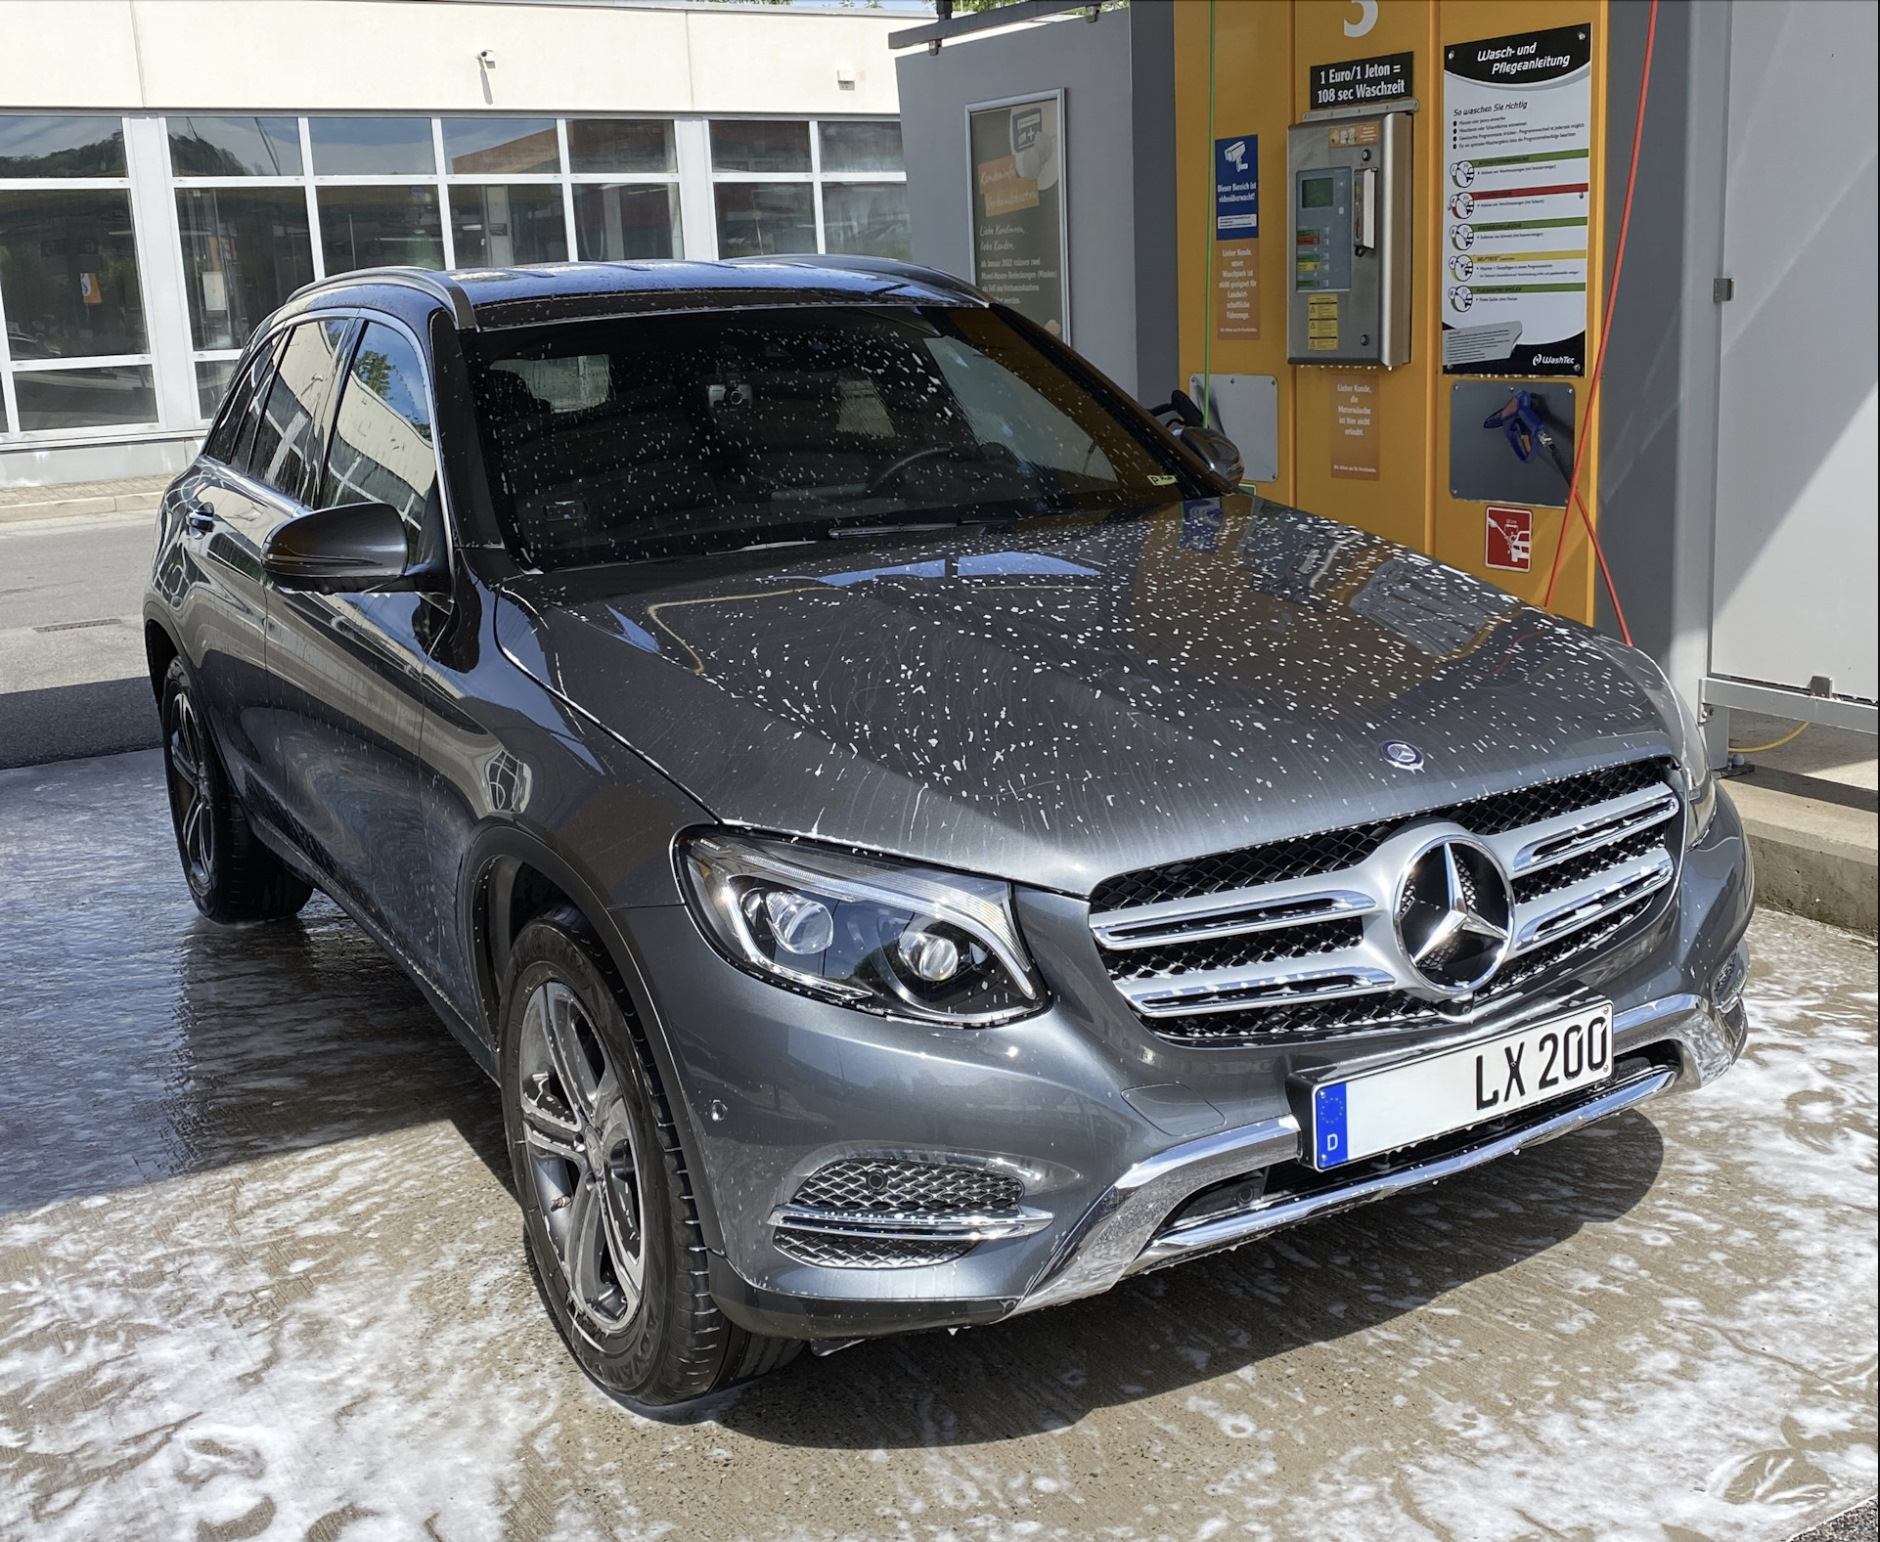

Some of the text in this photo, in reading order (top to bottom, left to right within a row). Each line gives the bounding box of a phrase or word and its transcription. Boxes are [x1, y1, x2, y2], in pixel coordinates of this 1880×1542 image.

[1477, 42, 1537, 61] Wasch- und
[1320, 64, 1401, 84] 1 Euro/1 Jeton =
[1491, 55, 1570, 75] Pflegeanleitung
[1317, 79, 1405, 103] 108 sec Waschzeit
[1453, 100, 1528, 117] So waschen Sie richtig
[1542, 356, 1575, 364] WashTec
[1476, 1016, 1608, 1111] LX 200
[1327, 1134, 1338, 1151] D
